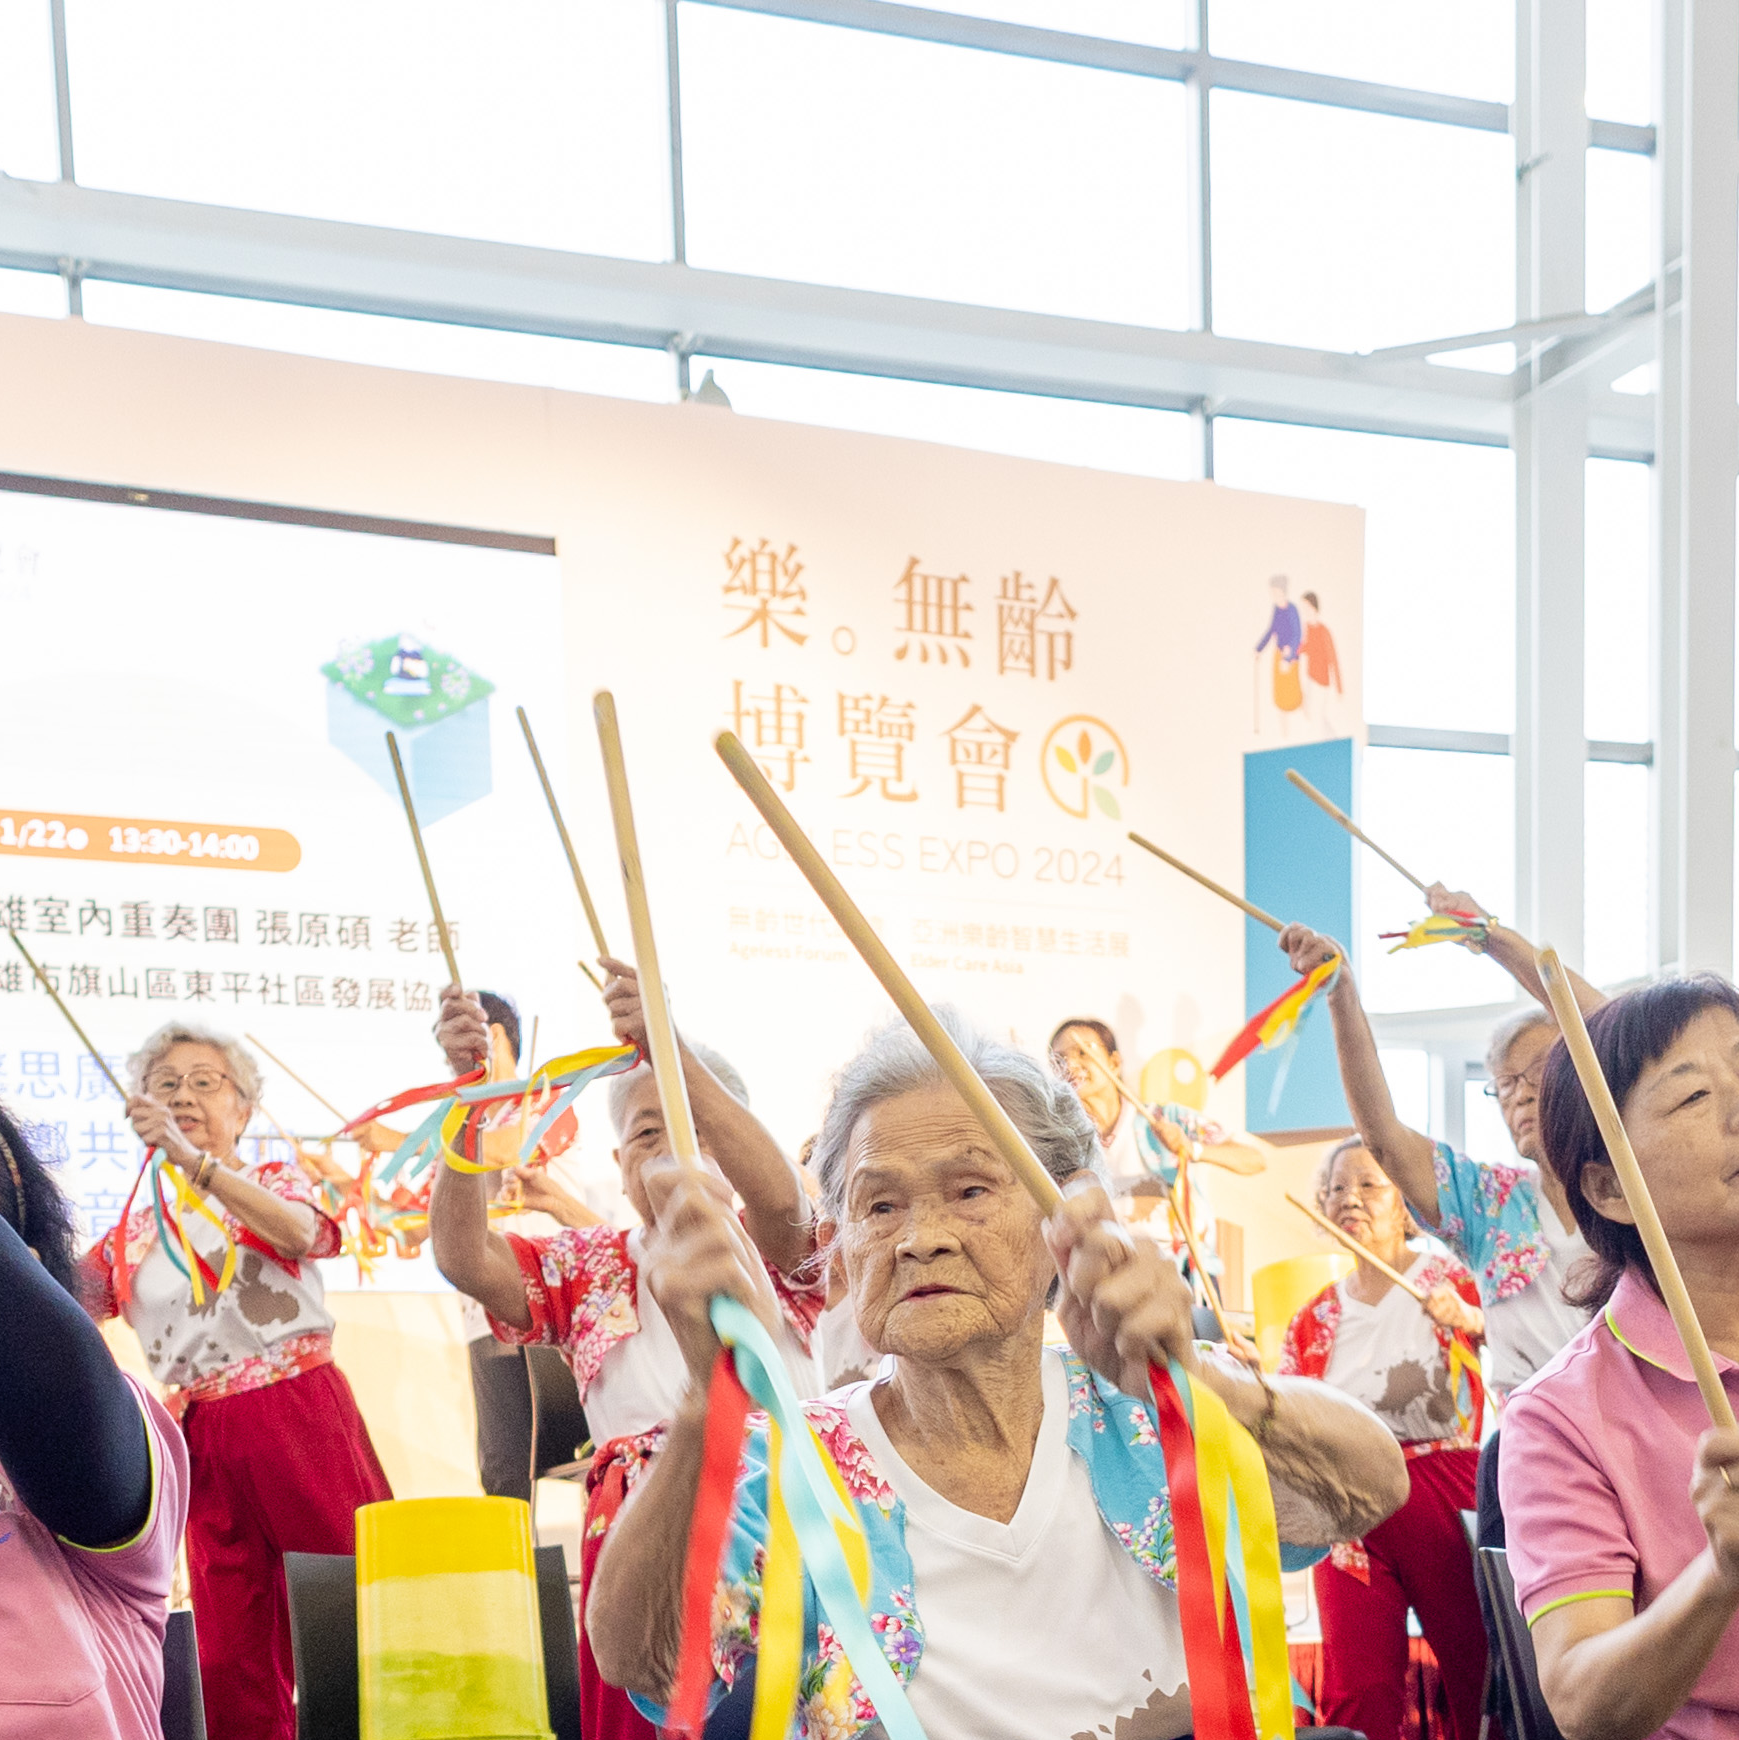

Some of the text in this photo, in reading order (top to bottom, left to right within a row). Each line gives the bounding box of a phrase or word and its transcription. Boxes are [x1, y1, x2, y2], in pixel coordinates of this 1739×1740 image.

[722, 678, 1022, 813] 博覽會
[725, 821, 1127, 887] AGESS EXPO 2024
[255, 909, 373, 951] 張原碩
[387, 916, 461, 954] 老師
[795, 944, 849, 963] Forum
[910, 952, 1025, 975] Elder Care Asia
